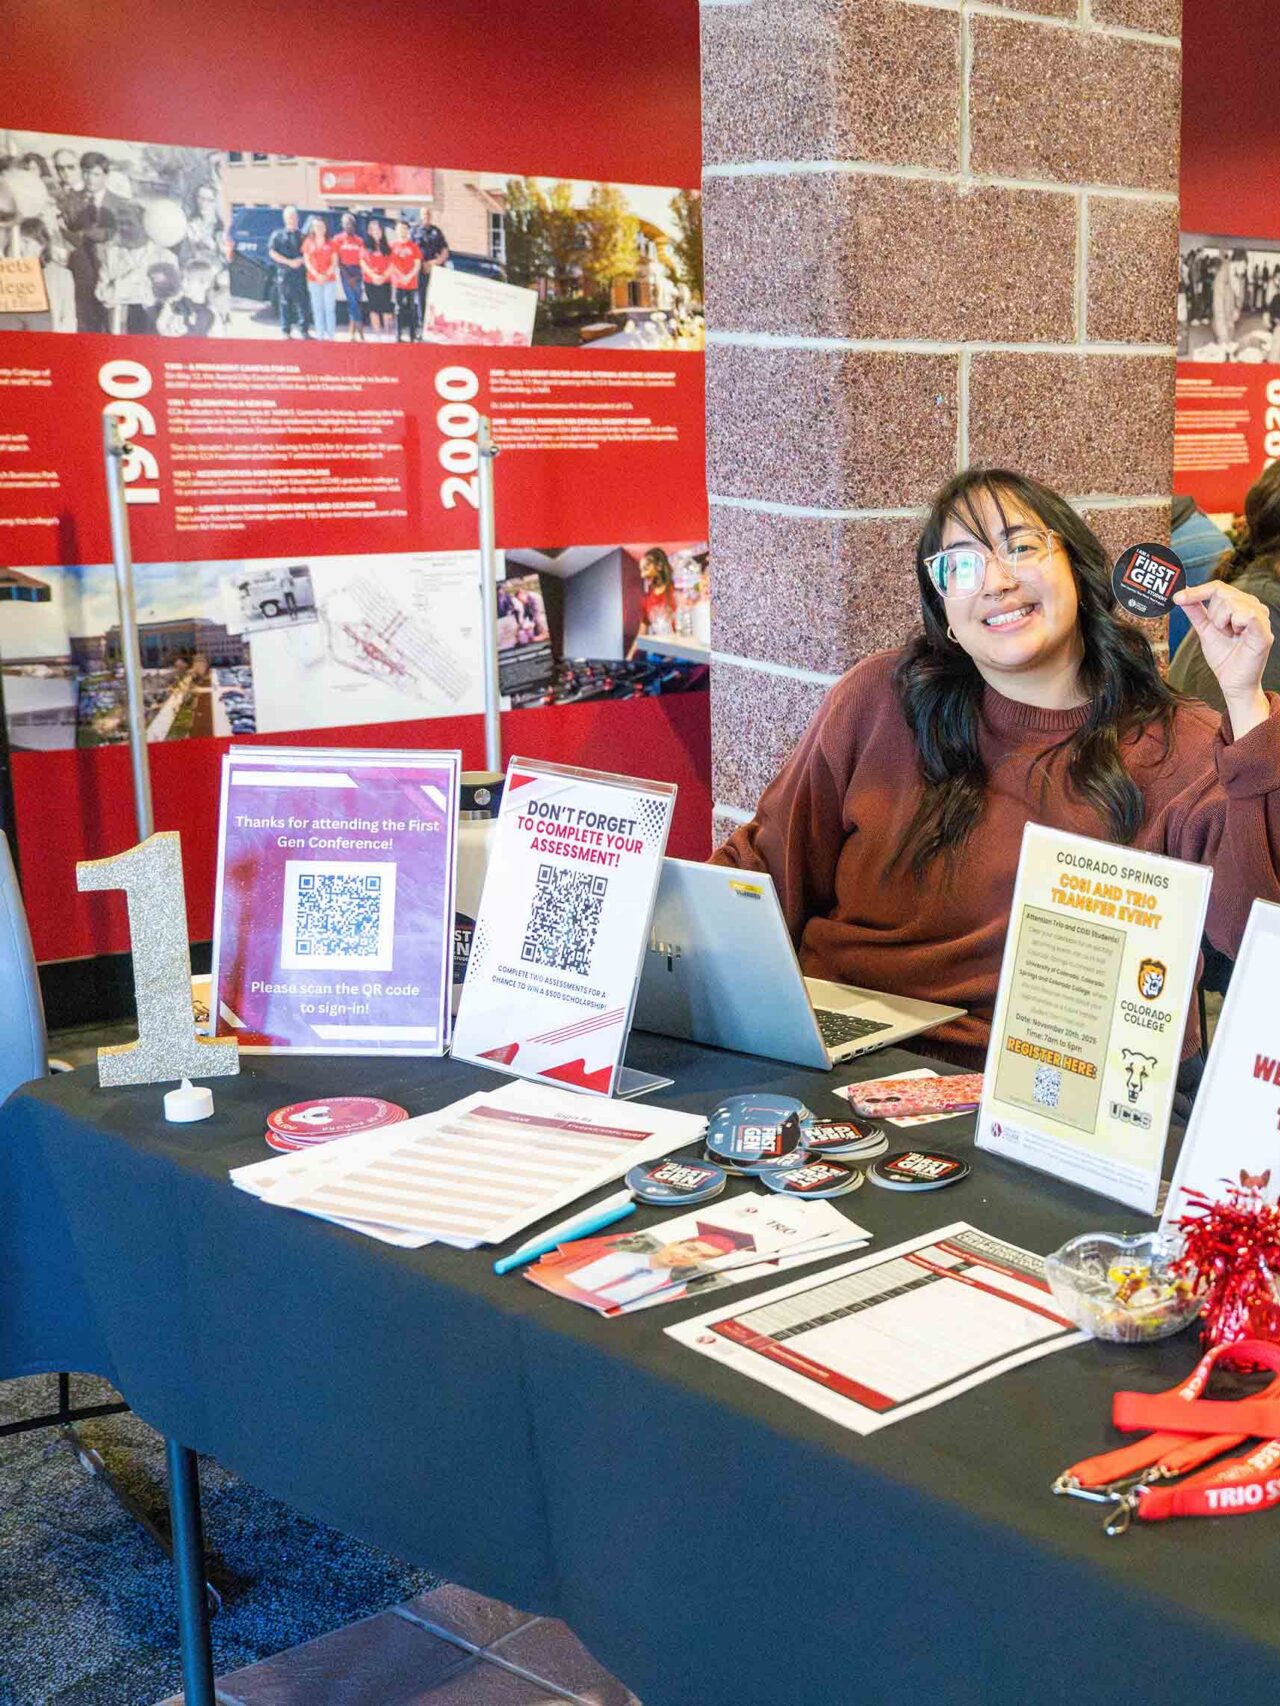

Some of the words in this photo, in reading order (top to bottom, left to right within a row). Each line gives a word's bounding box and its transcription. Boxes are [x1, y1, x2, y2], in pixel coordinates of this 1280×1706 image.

[98, 359, 160, 504] 1990
[434, 365, 480, 510] 2000
[1134, 554, 1176, 582] FIRST
[1130, 568, 1169, 595] GEN
[236, 816, 285, 829] Thanks
[288, 816, 309, 829] for
[311, 818, 379, 833] attending
[382, 819, 405, 831] the
[408, 818, 440, 832] First
[528, 800, 576, 825] DON'T
[576, 810, 637, 836] FORGET
[277, 836, 304, 848] Gen
[308, 836, 393, 850] Conference!
[518, 816, 534, 831] TO
[536, 820, 604, 846] COMPLETE
[606, 833, 643, 854] YOUR
[530, 836, 621, 868] ASSESSMENT!
[1057, 851, 1118, 877] COLORADO
[1121, 867, 1170, 889] SPRINGS
[1059, 873, 1091, 891] COSI
[1093, 882, 1122, 899] AND
[1126, 889, 1158, 910] TRIO
[1051, 887, 1117, 918] TRANSFER
[1117, 906, 1163, 930] EVENT
[1026, 912, 1053, 925] Attention
[1053, 920, 1065, 929] Trio
[1064, 923, 1076, 932] and
[251, 982, 297, 994] Please
[300, 984, 332, 994] scan
[336, 982, 359, 995] the
[362, 984, 382, 996] QR
[385, 984, 419, 996] code
[491, 975, 517, 989] CHANCE
[517, 981, 527, 990] TO
[526, 984, 540, 994] WIN
[562, 993, 607, 1010] SCHOLARSHIP!
[497, 965, 529, 979] COMPLETE
[544, 976, 588, 995] ASSESSMENTS
[587, 986, 601, 997] FOR
[601, 991, 606, 999] A
[300, 1003, 315, 1014] to
[318, 1003, 369, 1017] sign-in!
[1120, 1000, 1172, 1023] COLORADO
[1033, 1018, 1064, 1034] November
[1124, 1013, 1165, 1033] COLLEGE
[1026, 1028, 1043, 1040] Time:
[1045, 1033, 1059, 1045] 7am
[1006, 1036, 1062, 1067] REGISTER
[1062, 1055, 1098, 1079] HERE:
[1109, 1102, 1152, 1130] UCCS
[743, 1127, 762, 1151] GEN
[661, 1162, 711, 1181] FIRST
[897, 1160, 940, 1176] GEN
[903, 1152, 952, 1172] FIRST
[653, 1171, 702, 1186] GEN
[766, 1219, 796, 1235] TRIO
[1204, 1483, 1263, 1508] TRIO
